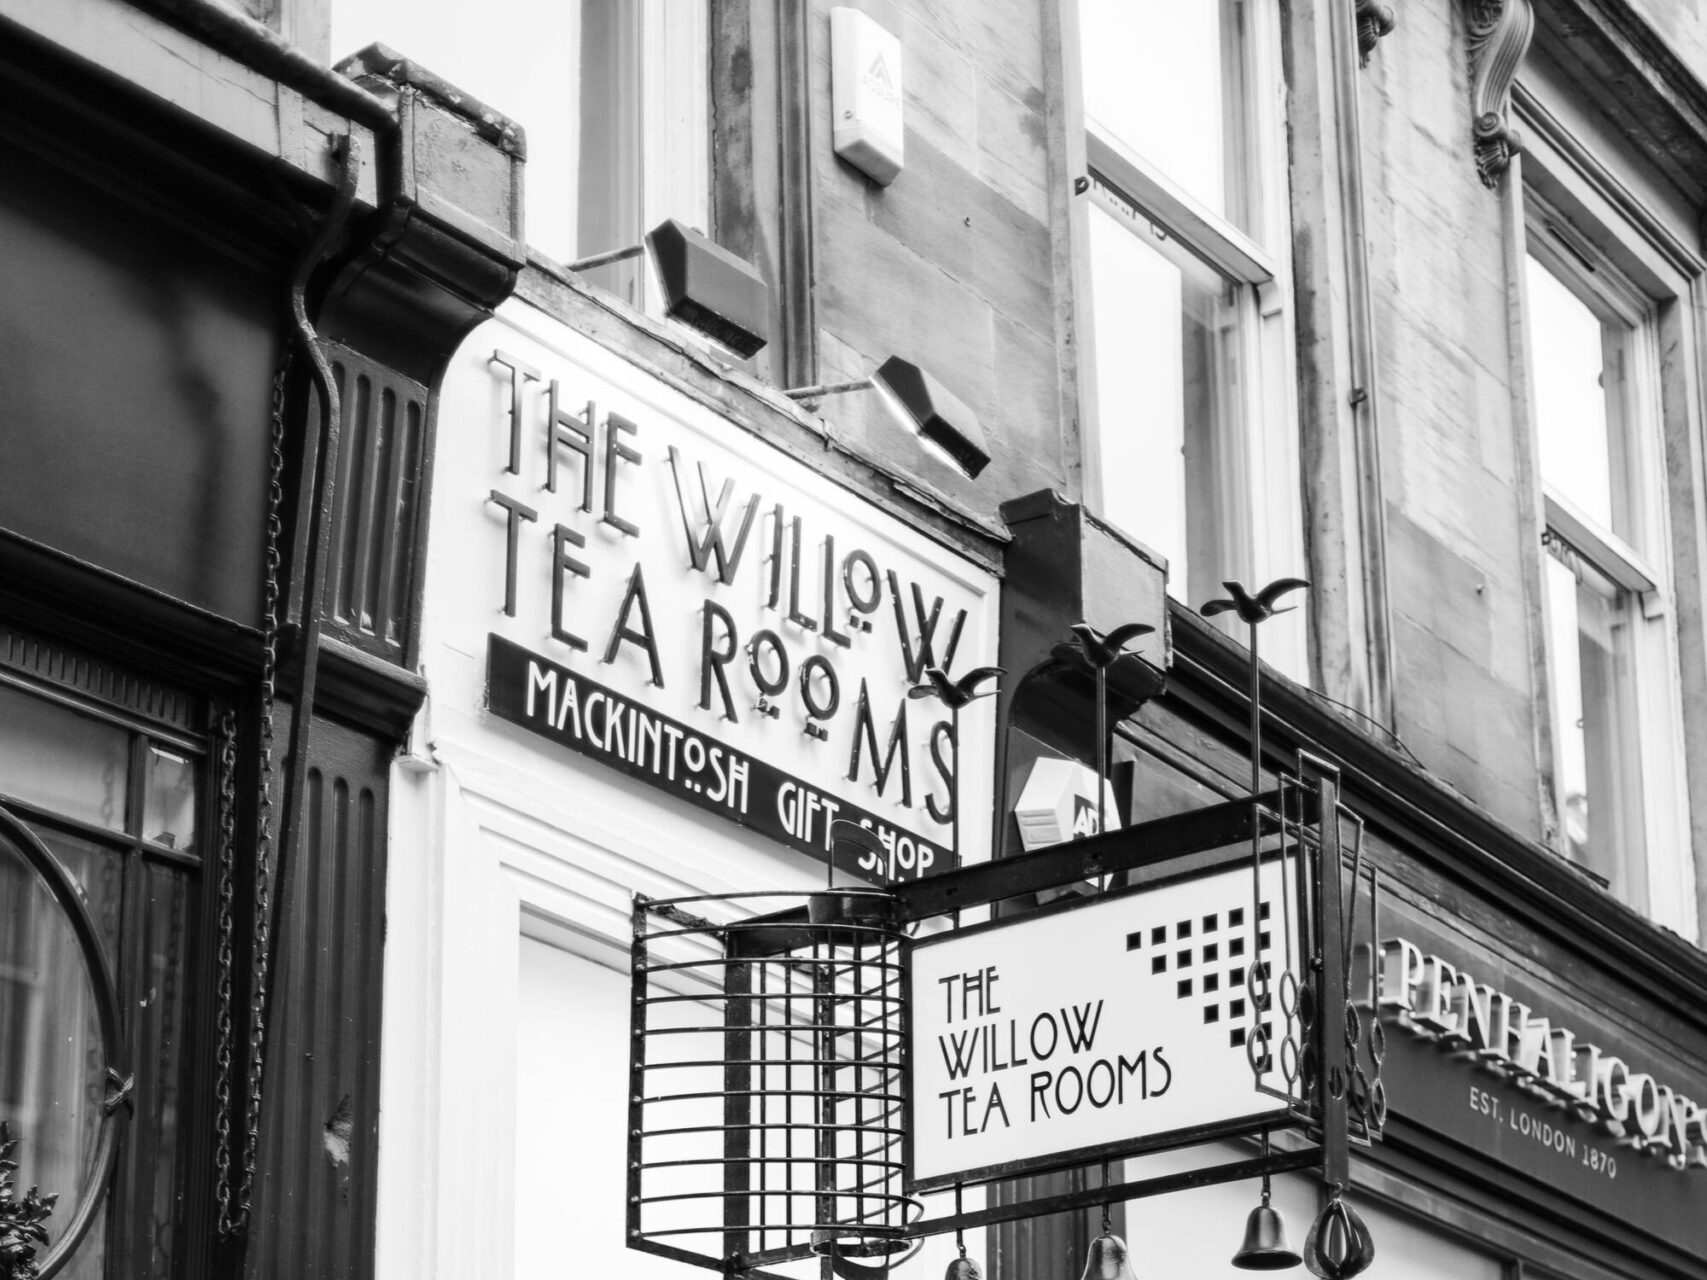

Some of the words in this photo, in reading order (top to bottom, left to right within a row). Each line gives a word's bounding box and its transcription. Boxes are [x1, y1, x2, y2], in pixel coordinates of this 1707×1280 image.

[489, 349, 643, 539] THE
[667, 444, 968, 686] WILLOW
[487, 489, 664, 689] TEA
[700, 598, 957, 826] ROOMS
[526, 660, 749, 814] MACKINTOSH
[777, 781, 840, 852] GIFT
[938, 966, 1001, 1024] THE
[938, 1000, 1104, 1081] WILLOW
[938, 1081, 1011, 1139] TEA
[1031, 1046, 1172, 1123] ROOMS
[1469, 1086, 1504, 1123] EST.
[1510, 1107, 1576, 1159] LONDON
[1582, 1143, 1617, 1179] 1870
